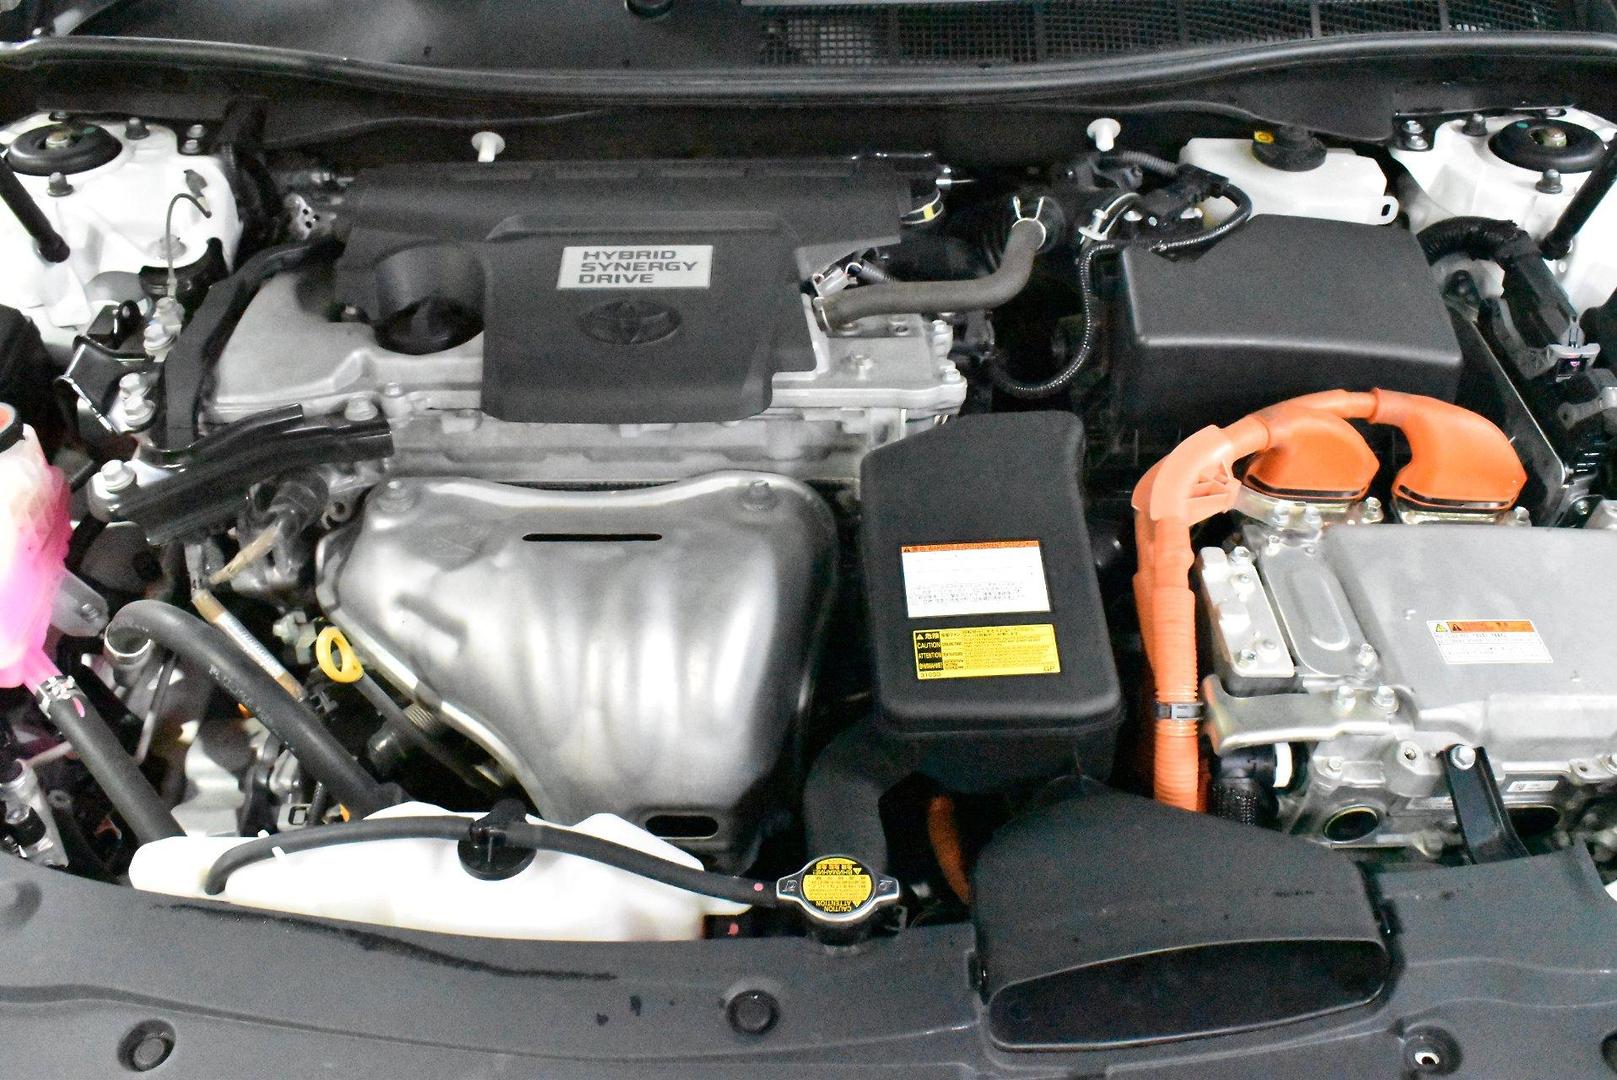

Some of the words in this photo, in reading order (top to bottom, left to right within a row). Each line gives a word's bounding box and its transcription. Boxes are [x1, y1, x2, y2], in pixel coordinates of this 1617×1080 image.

[582, 250, 677, 260] HYBRID
[580, 261, 698, 272] SYNERGY
[578, 273, 655, 284] DRIVE
[917, 641, 941, 649] CAUTION
[918, 651, 942, 659] ATTENTION
